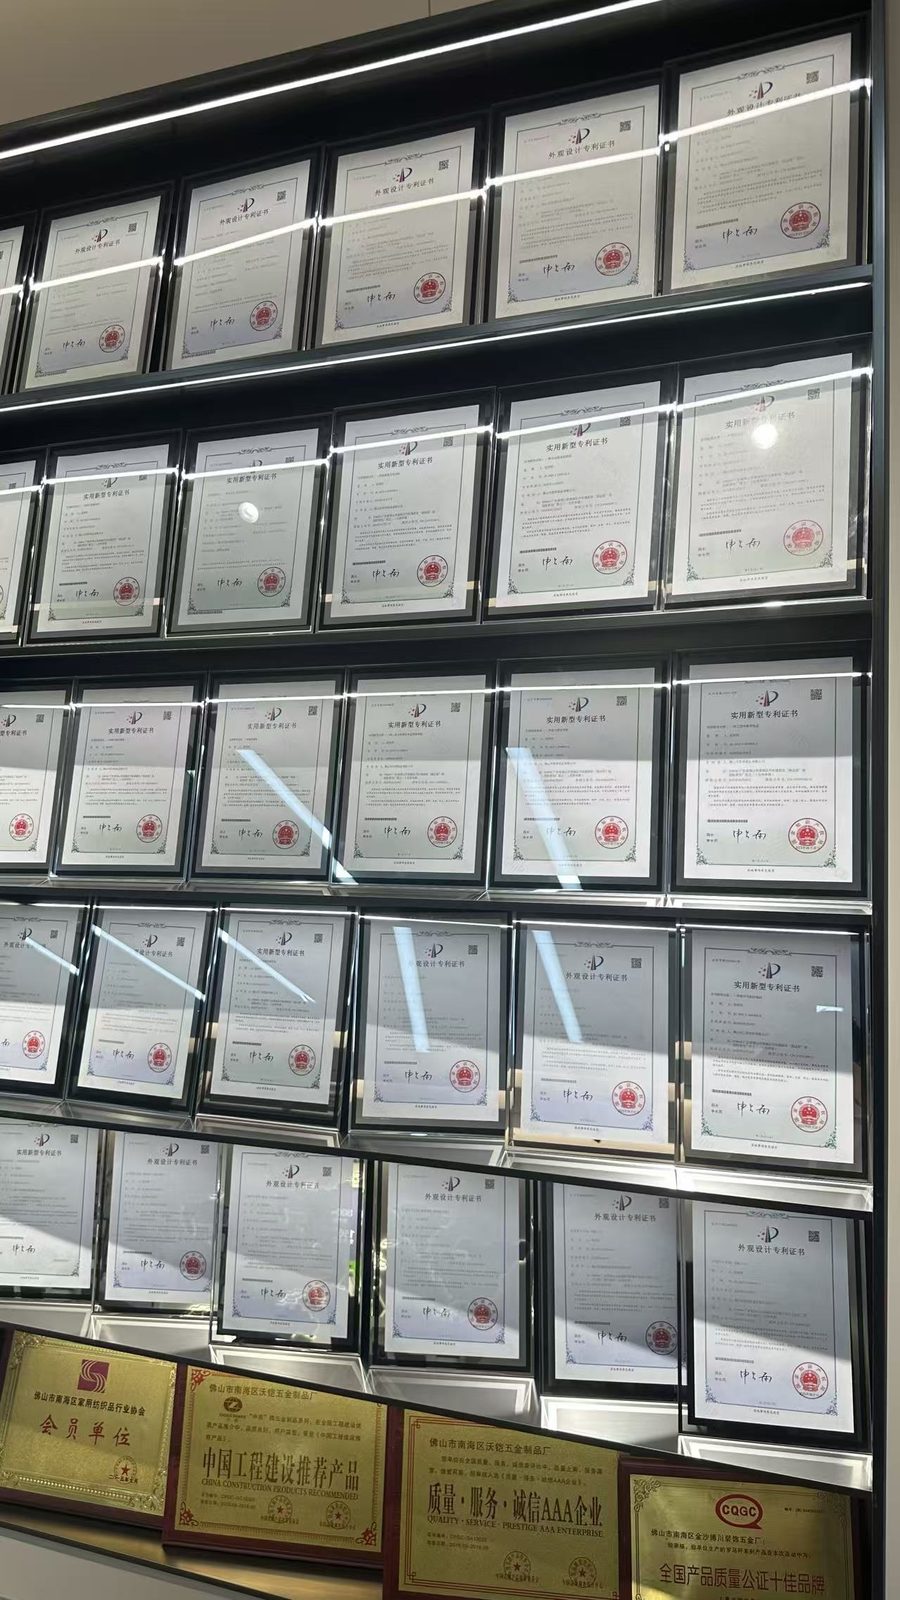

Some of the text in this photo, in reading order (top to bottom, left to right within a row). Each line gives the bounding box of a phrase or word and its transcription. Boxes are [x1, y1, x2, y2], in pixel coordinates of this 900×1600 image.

[548, 140, 616, 159] 外观设计专利证书
[374, 178, 435, 197] 外观设计专利证书
[219, 209, 270, 225] 外观设计专利证书
[546, 437, 609, 453] 实用新型专利证书
[377, 456, 434, 470] 实用新型专利证书
[226, 473, 277, 484] 实用新型专利证书
[546, 714, 606, 724] 实用新型专利证书
[731, 709, 798, 720] 实用新型专利证书
[247, 722, 297, 731] 实用新型专利证书
[388, 720, 441, 729] 实用新型专利证书
[566, 971, 628, 983] 外观设计专利证书
[734, 981, 800, 993] 实用新型专利证书
[424, 1192, 482, 1203] 外观设计专利证书
[594, 1212, 656, 1223] 外观设计专利证书
[738, 1243, 805, 1256] 外观设计专利证书
[34, 1391, 146, 1416] 佛山市南海区家用纺织品行业协会
[39, 1414, 130, 1446] 会员单位
[203, 1447, 359, 1491] 中国工程建设推荐产品
[201, 1478, 359, 1500] CHINA CONSTRUCTION PRODUCTS RECOMMENDED
[722, 1504, 757, 1517] CQGC
[427, 1515, 604, 1537] QUALITY SERVICE PRESTIGE AAA ENTERPRISE
[659, 1563, 825, 1595] 全国产品质量公证十佳品牌
